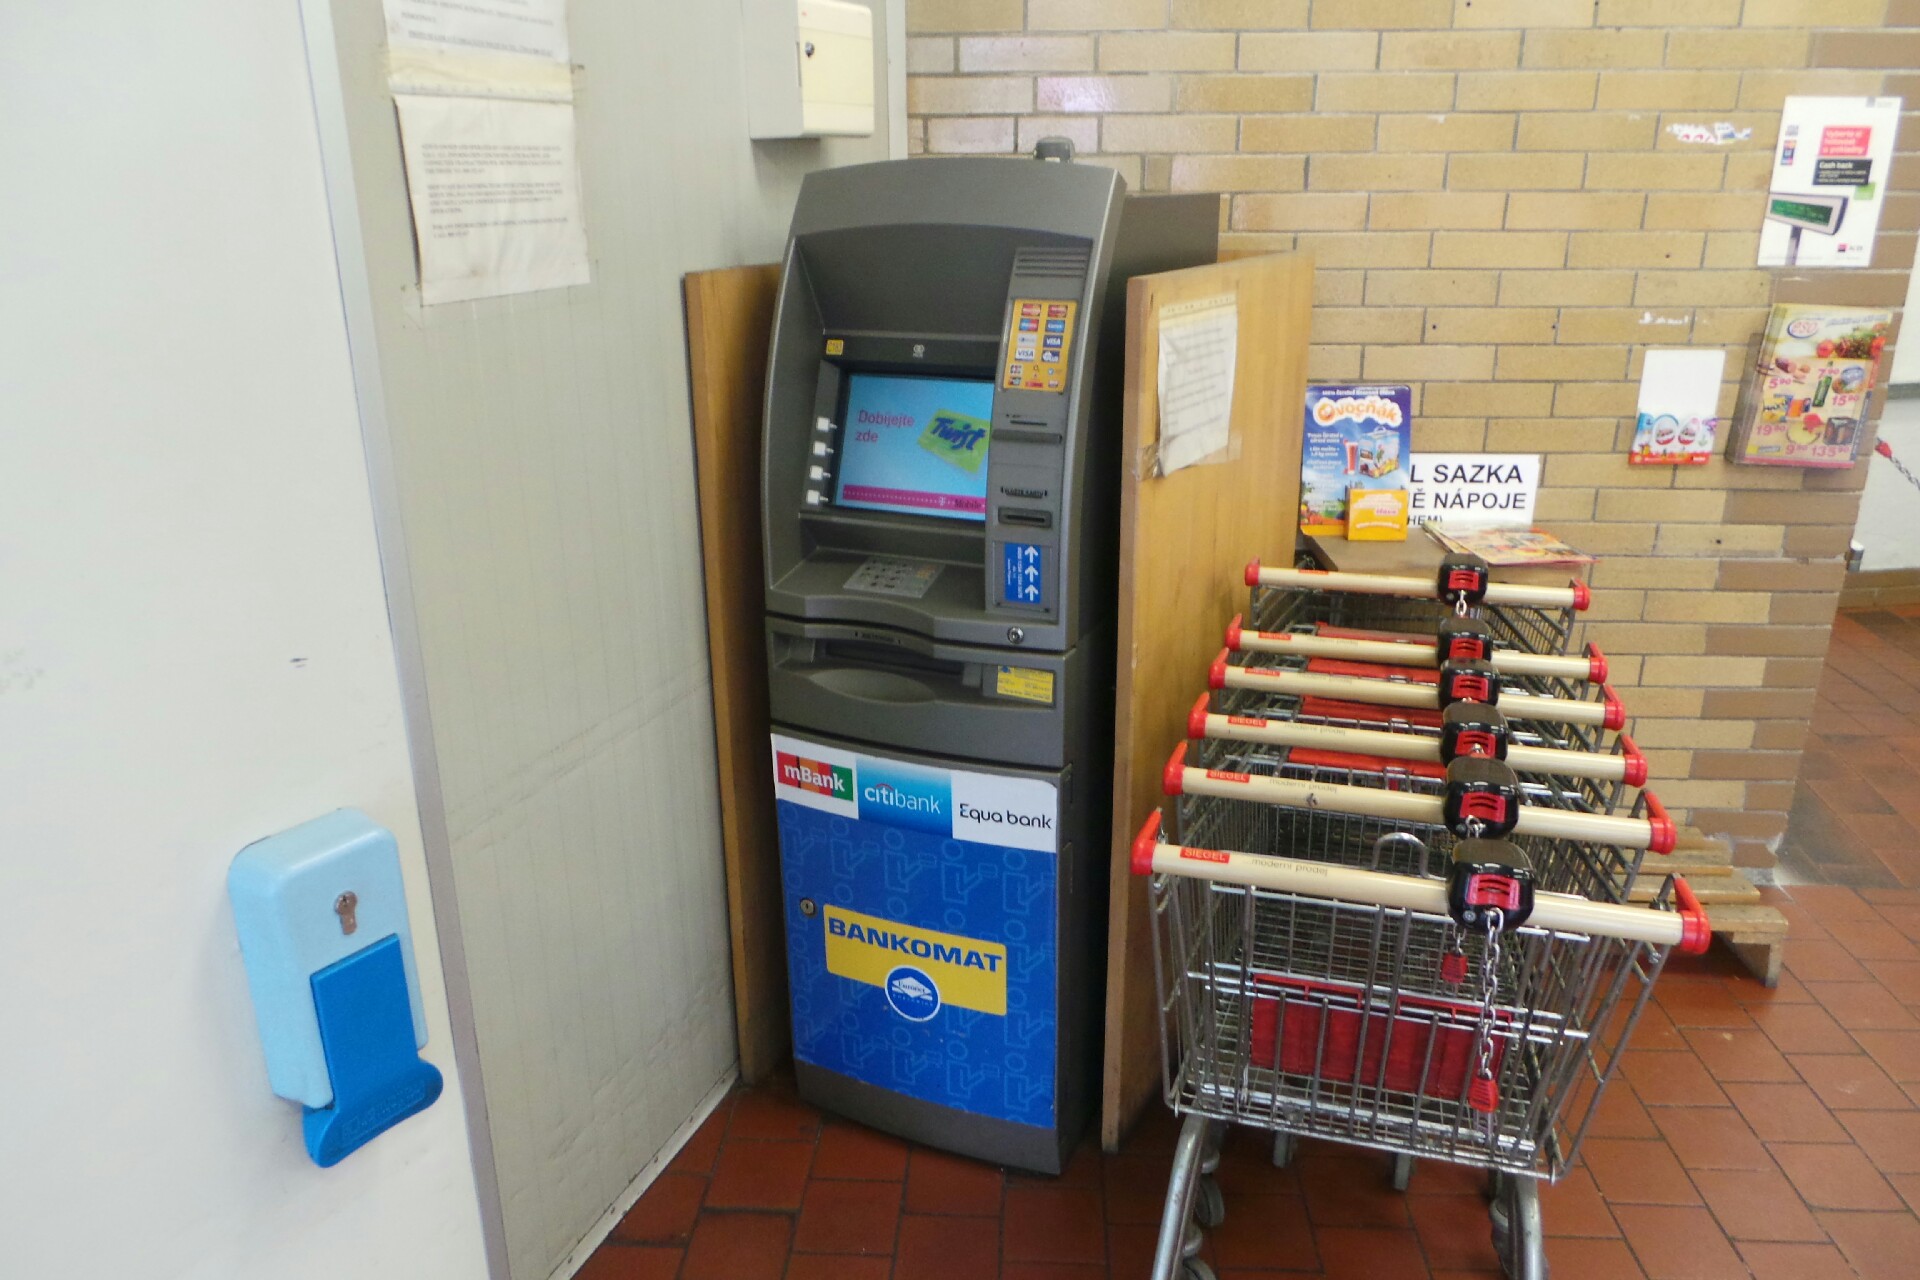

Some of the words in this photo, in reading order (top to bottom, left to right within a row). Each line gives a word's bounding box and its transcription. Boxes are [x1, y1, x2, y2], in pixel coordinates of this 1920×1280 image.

[855, 429, 879, 442] zde
[930, 417, 987, 450] Twist
[1432, 464, 1523, 483] SAZKA
[1433, 487, 1527, 509] NÁPOJE
[783, 763, 846, 793] mBank
[863, 784, 942, 816] citibank
[959, 803, 1003, 824] Equa
[1006, 810, 1052, 829] bank
[1185, 848, 1226, 862] SIEGEL
[1295, 863, 1329, 877] prodej
[828, 917, 1002, 974] BANKOMAT
